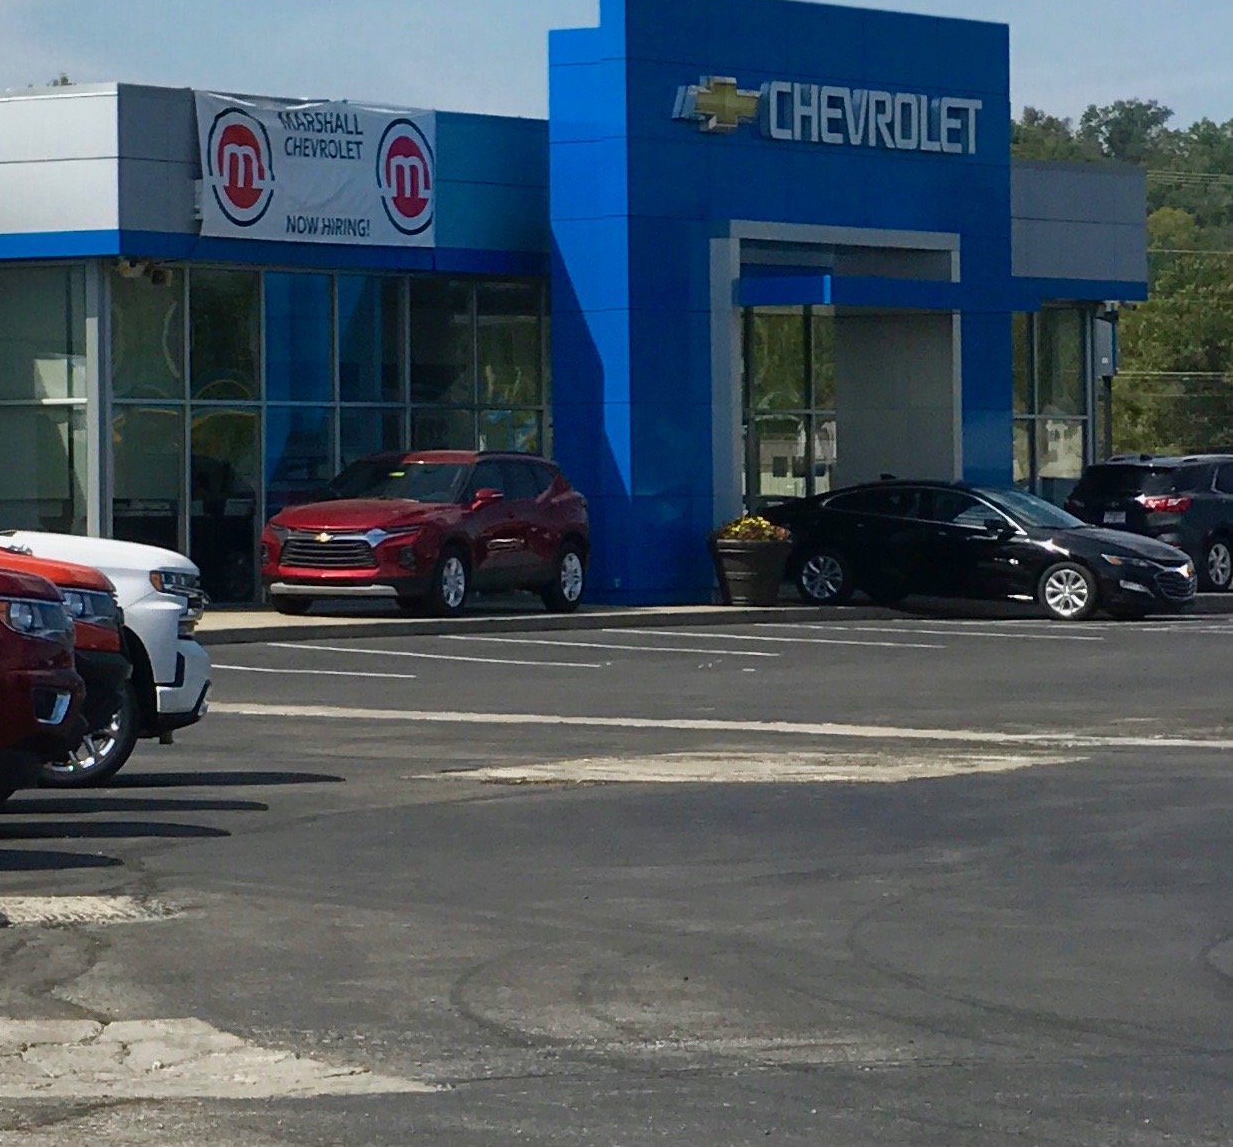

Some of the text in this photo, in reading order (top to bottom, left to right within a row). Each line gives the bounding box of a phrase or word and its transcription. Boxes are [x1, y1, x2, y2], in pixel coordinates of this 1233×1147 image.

[277, 111, 364, 136] MARSHALL
[767, 80, 983, 155] CHEVROLET
[284, 136, 363, 160] CHEVROLET
[286, 214, 371, 237] NOW HIRING!
